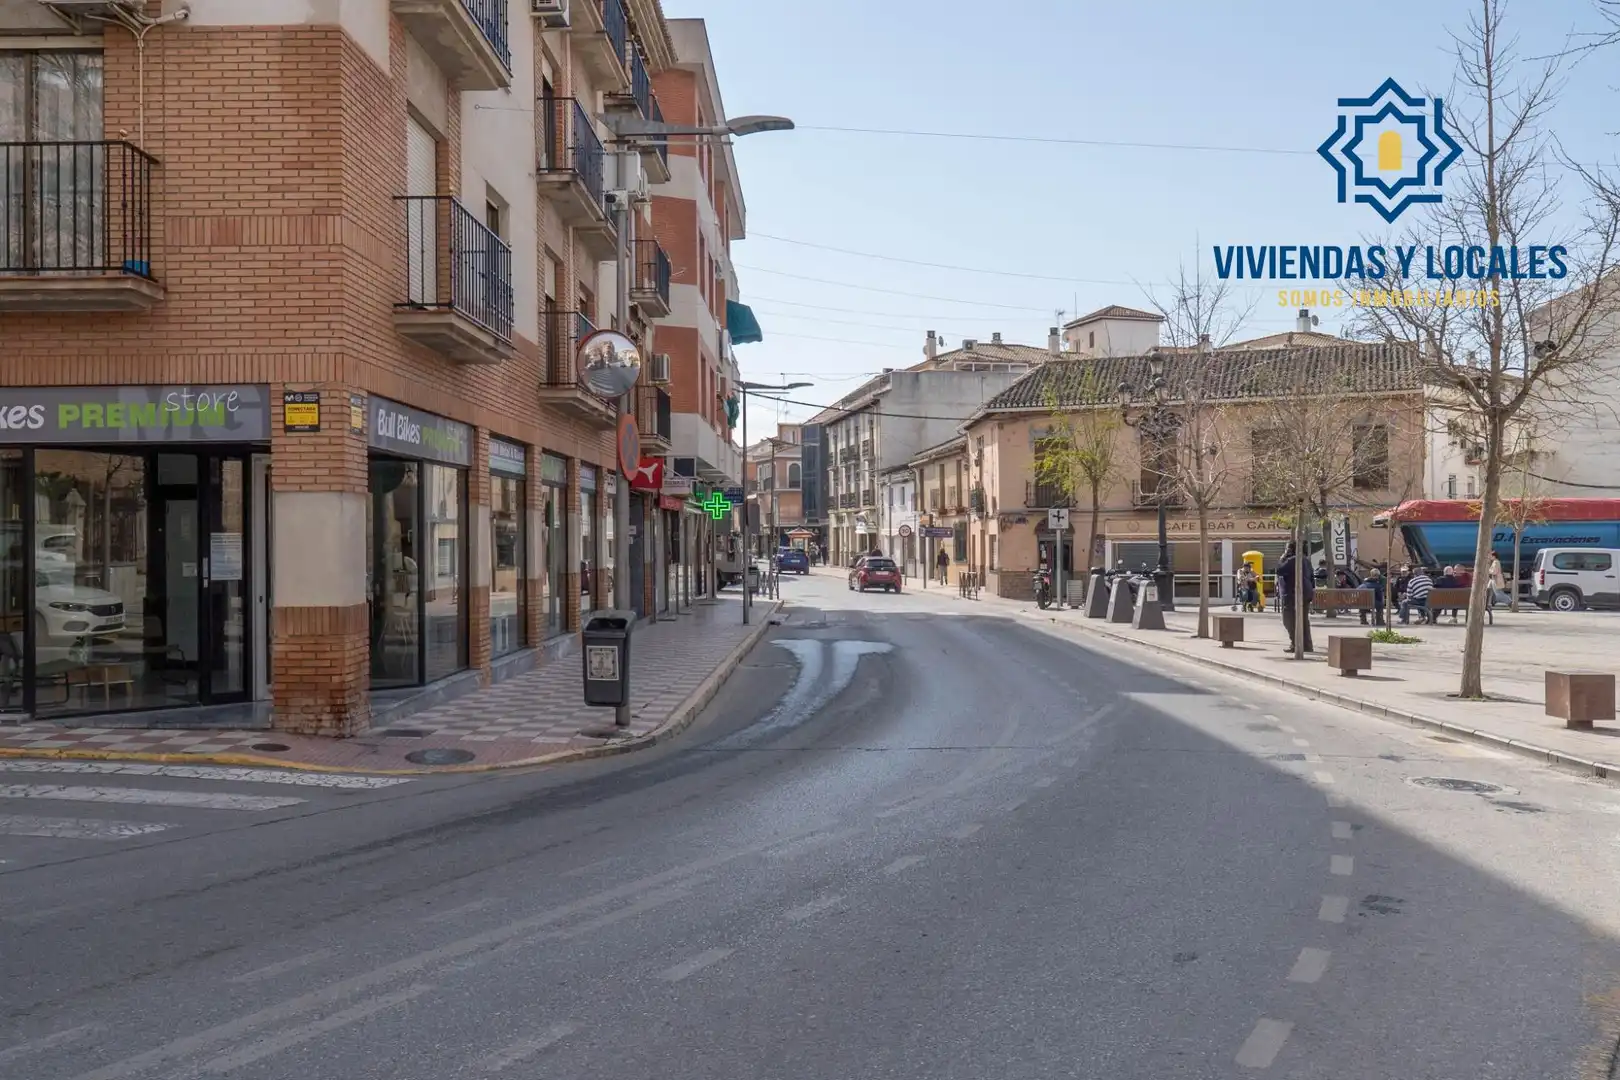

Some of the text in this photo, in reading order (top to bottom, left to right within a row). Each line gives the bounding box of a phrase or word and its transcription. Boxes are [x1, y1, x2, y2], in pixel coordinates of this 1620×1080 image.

[164, 387, 240, 412] store
[58, 402, 225, 429] PREMIUM
[377, 409, 396, 438] Bull
[397, 414, 420, 445] Bikes
[1207, 521, 1235, 530] BAR
